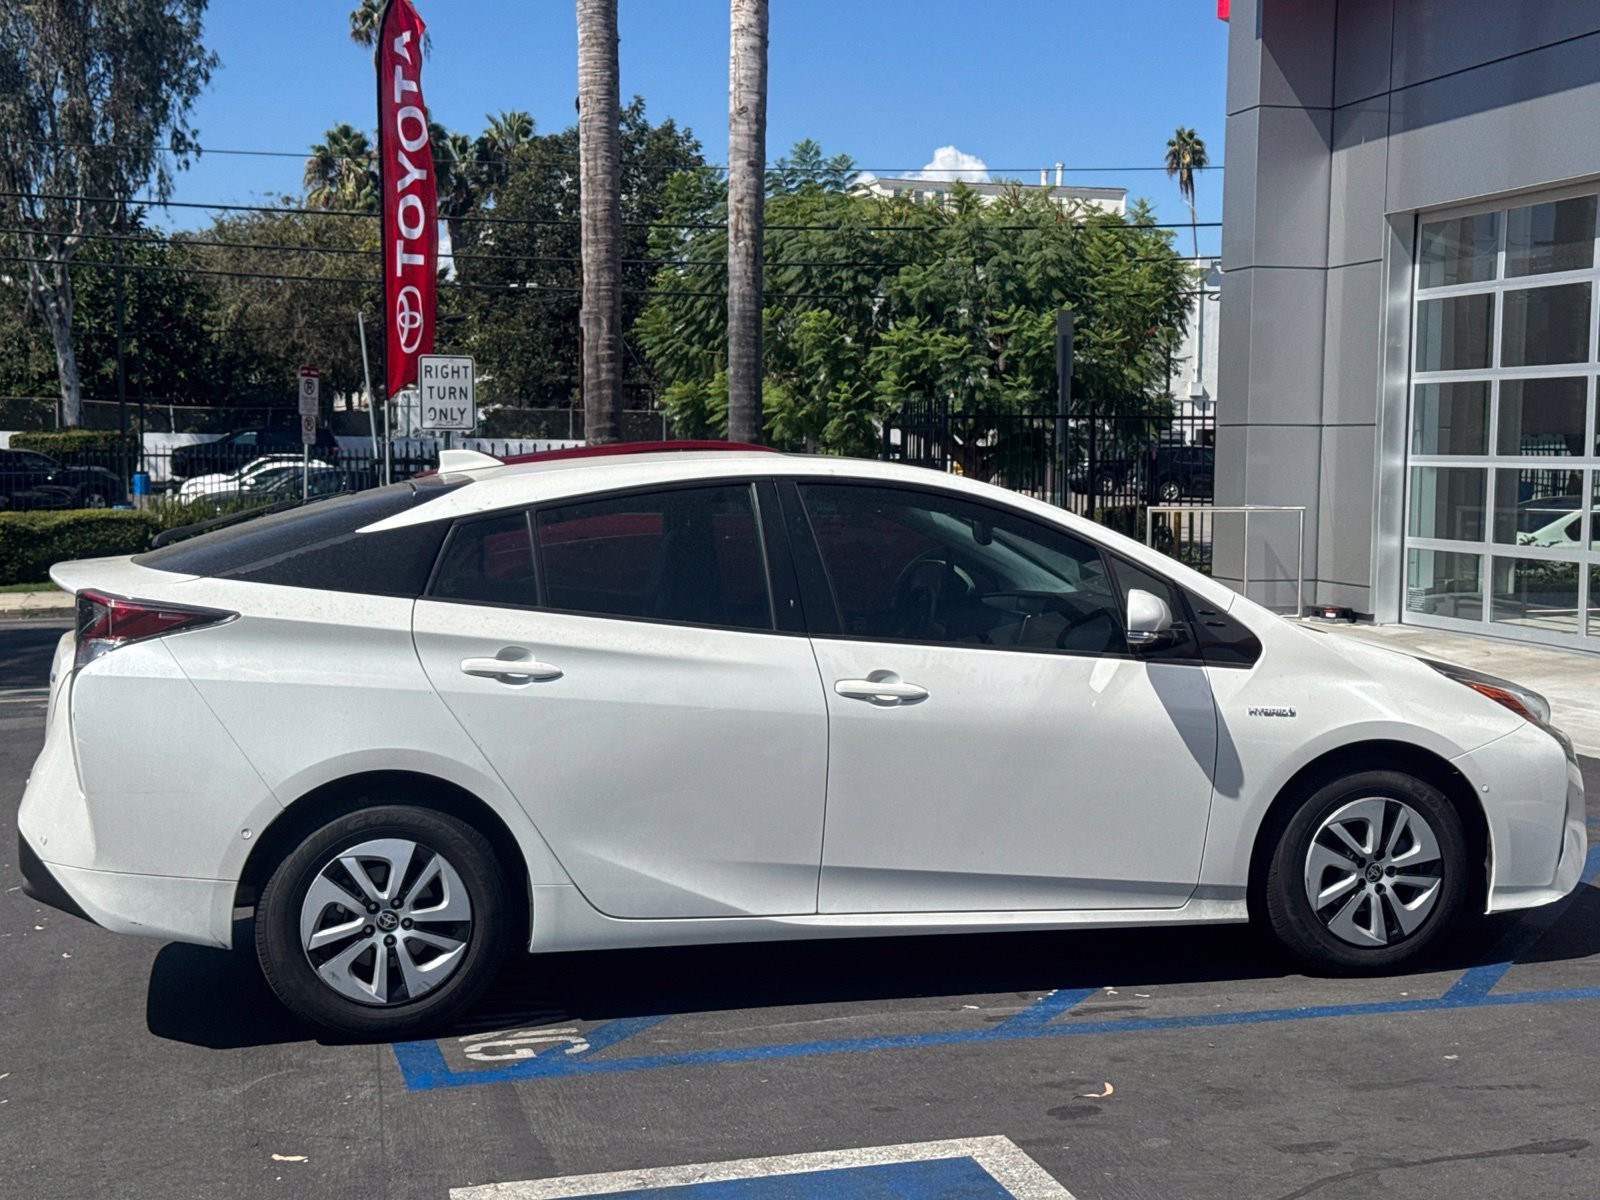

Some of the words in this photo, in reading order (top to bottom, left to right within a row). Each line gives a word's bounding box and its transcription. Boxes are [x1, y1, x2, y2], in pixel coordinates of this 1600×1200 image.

[394, 30, 428, 277] TOYOTA
[424, 364, 470, 379] RIGHT
[427, 386, 468, 400] TURN
[428, 407, 467, 421] ONLY
